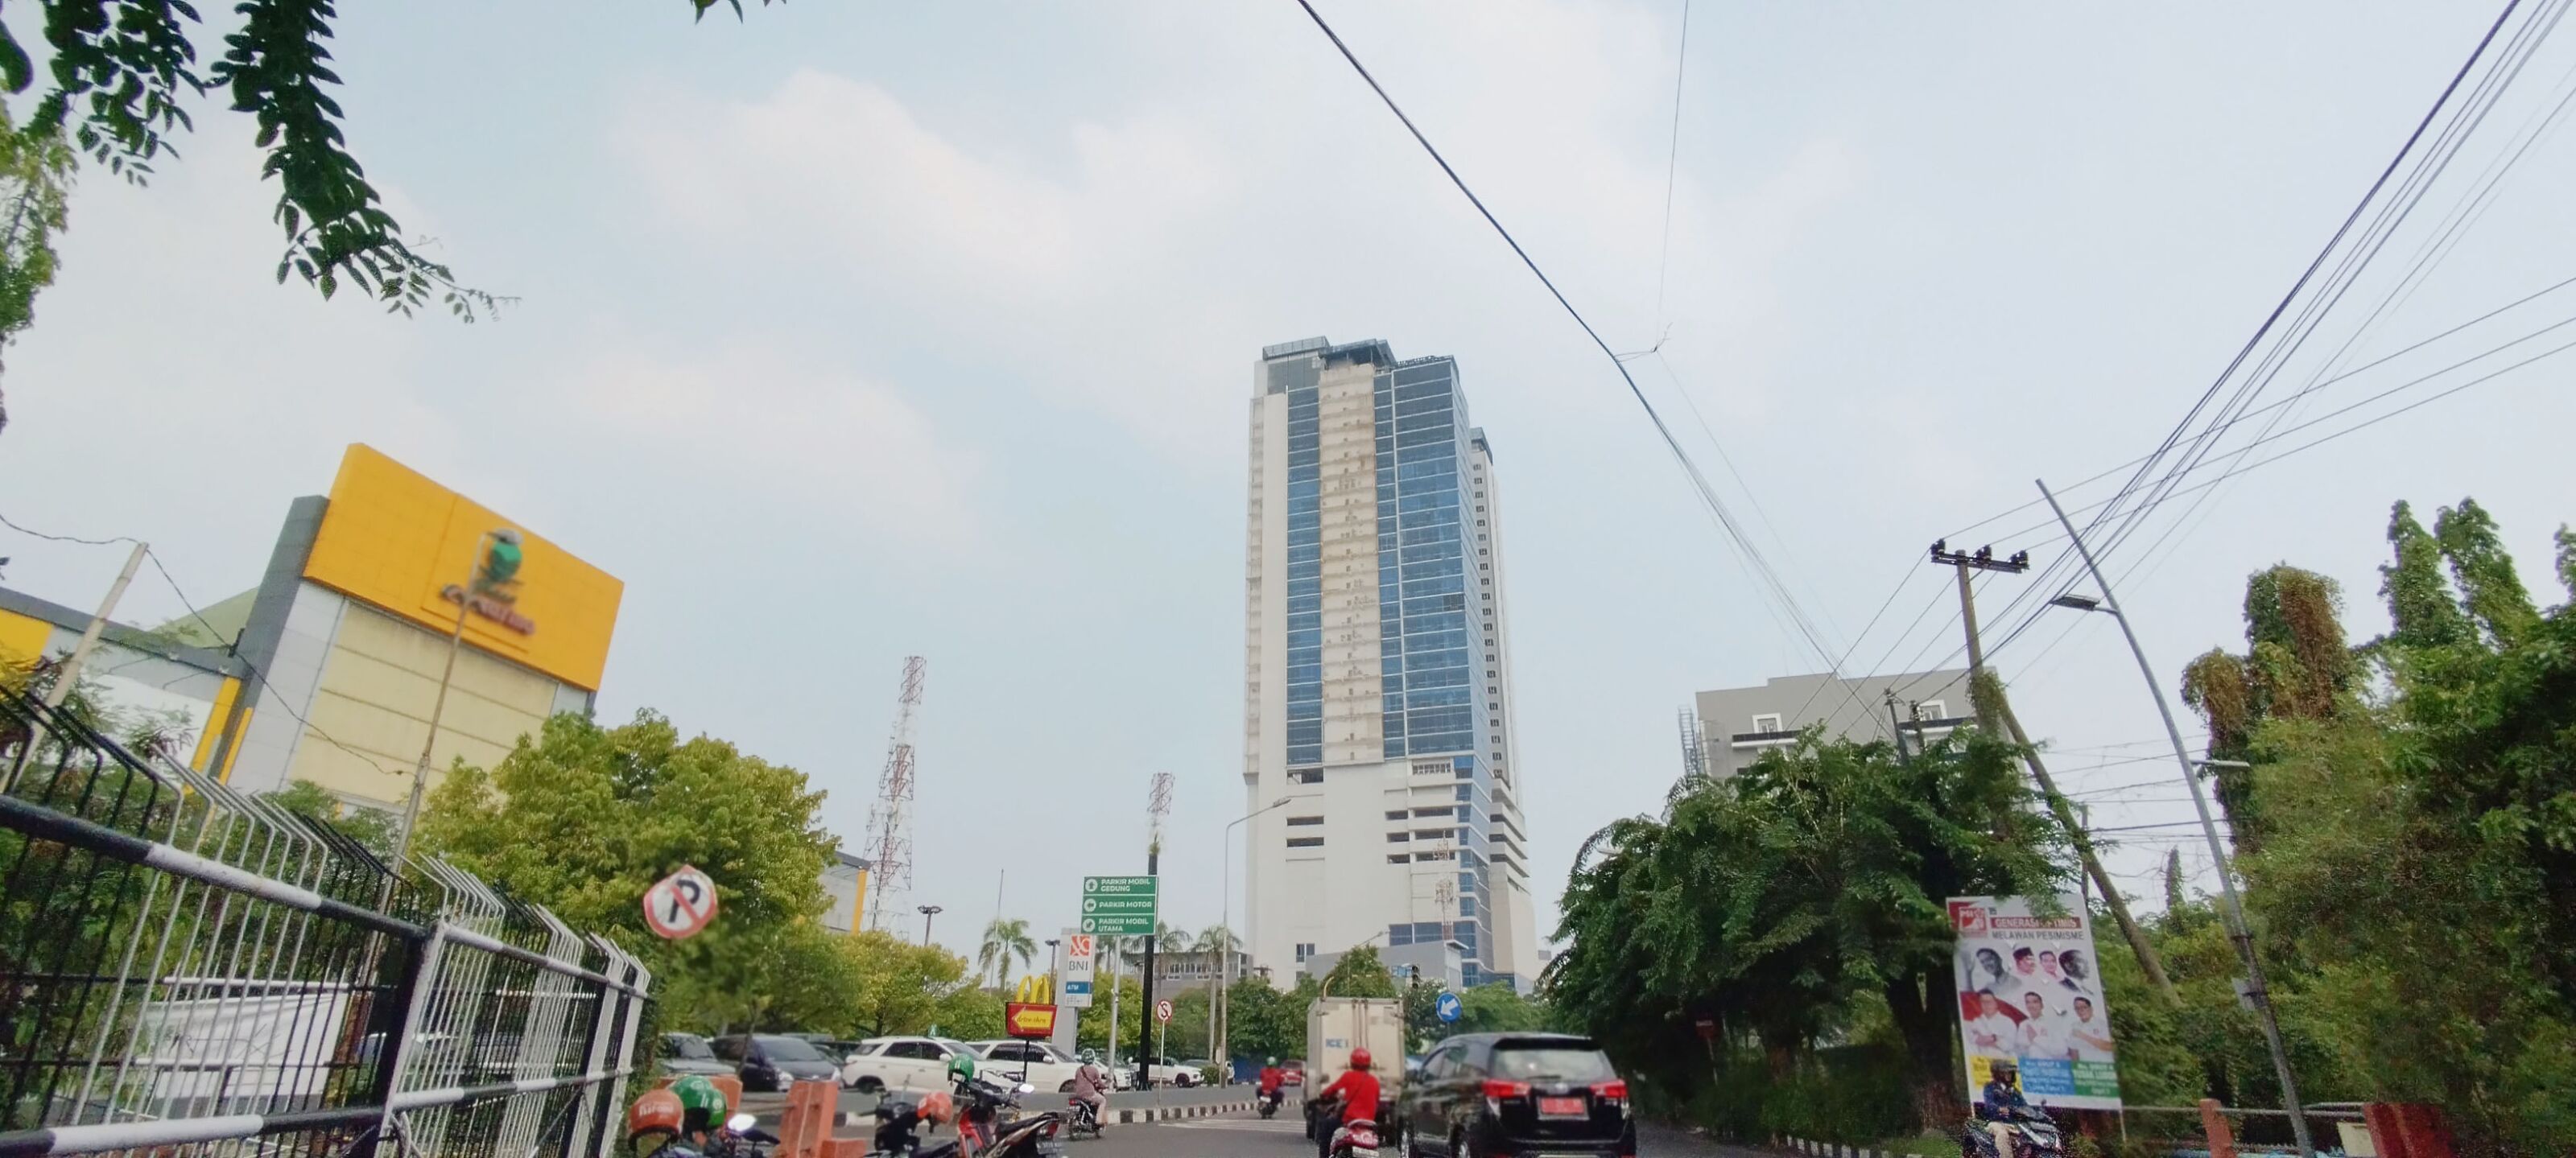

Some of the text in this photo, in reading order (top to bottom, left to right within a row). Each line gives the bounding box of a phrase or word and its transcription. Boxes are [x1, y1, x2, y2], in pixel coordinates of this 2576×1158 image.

[1992, 931, 2035, 940] MELAWAN
[2036, 931, 2084, 940] PESIMISME
[1068, 961, 1088, 970] BNI
